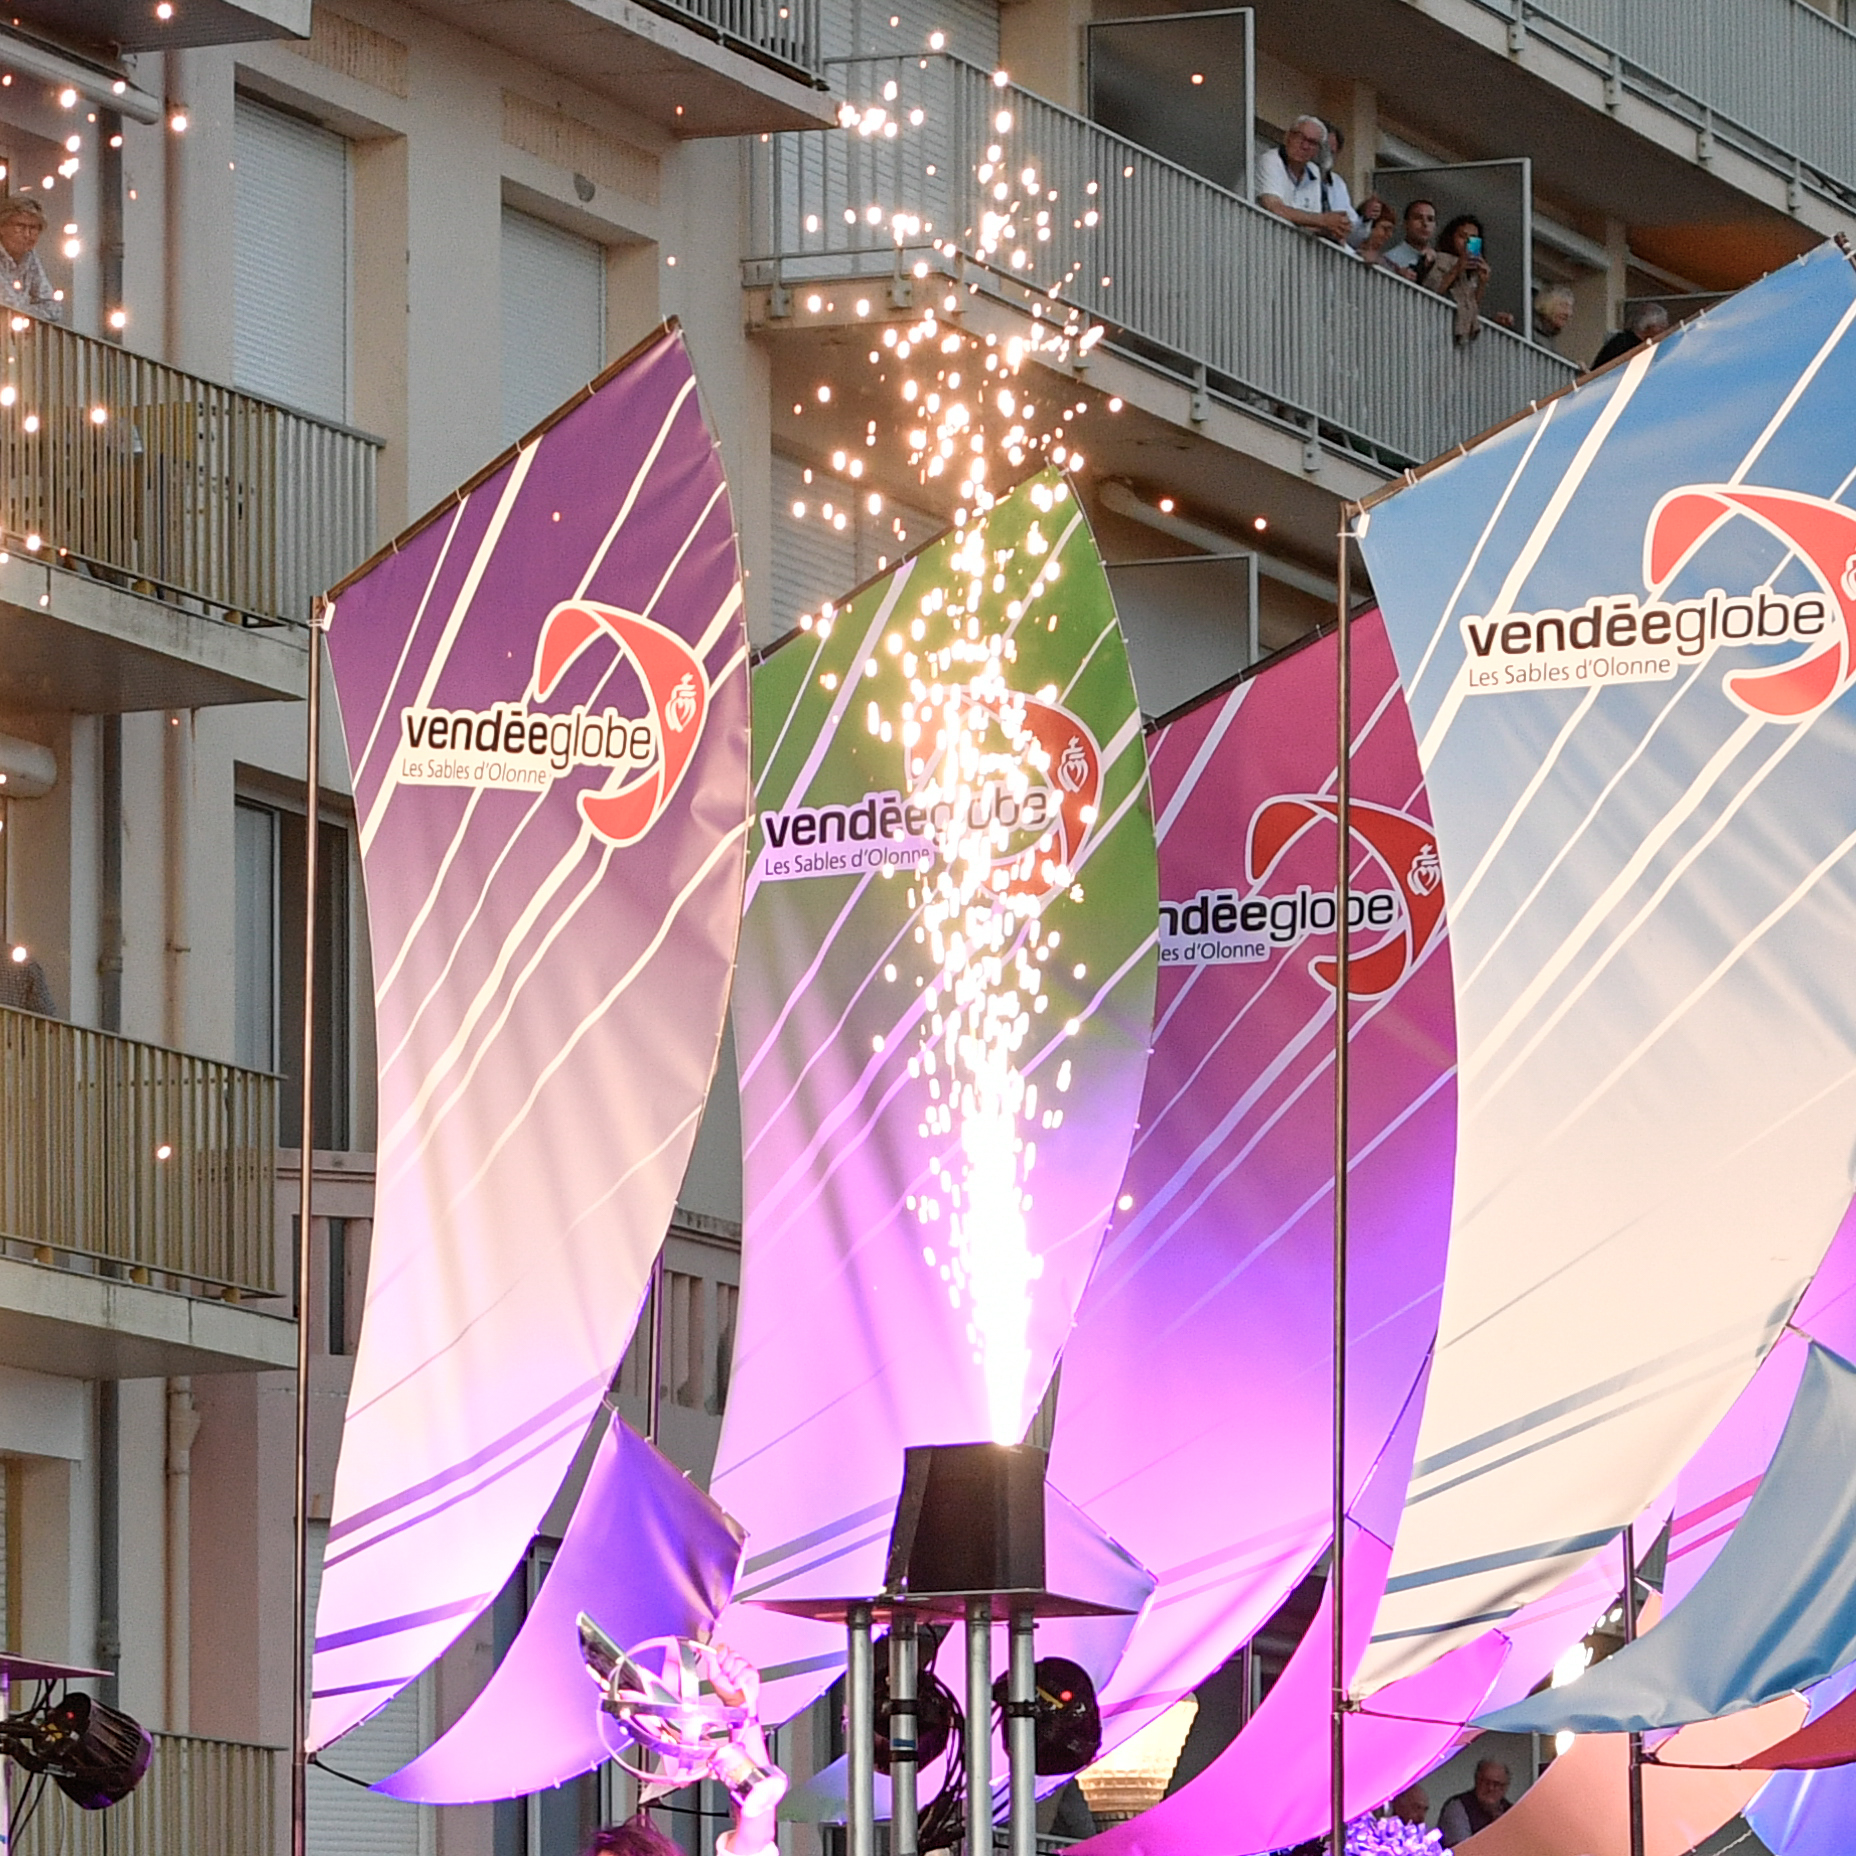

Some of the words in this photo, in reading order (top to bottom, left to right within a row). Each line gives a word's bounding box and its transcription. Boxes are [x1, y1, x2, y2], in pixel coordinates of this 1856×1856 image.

[1468, 595, 1825, 657] vendéeglobe
[1469, 667, 1499, 687] Les
[1505, 662, 1570, 685] Sables
[1576, 657, 1671, 680] d'Olonne
[406, 710, 651, 770] vendéeglobe
[401, 758, 424, 778] Les
[427, 760, 470, 781] Sables
[474, 761, 546, 785] d'Olonne
[765, 786, 1047, 848] vendéegobe
[765, 857, 790, 876] Les
[795, 851, 846, 874] Sables
[1159, 890, 1394, 942] ndéegloe
[1184, 941, 1266, 961] d'Olonne
